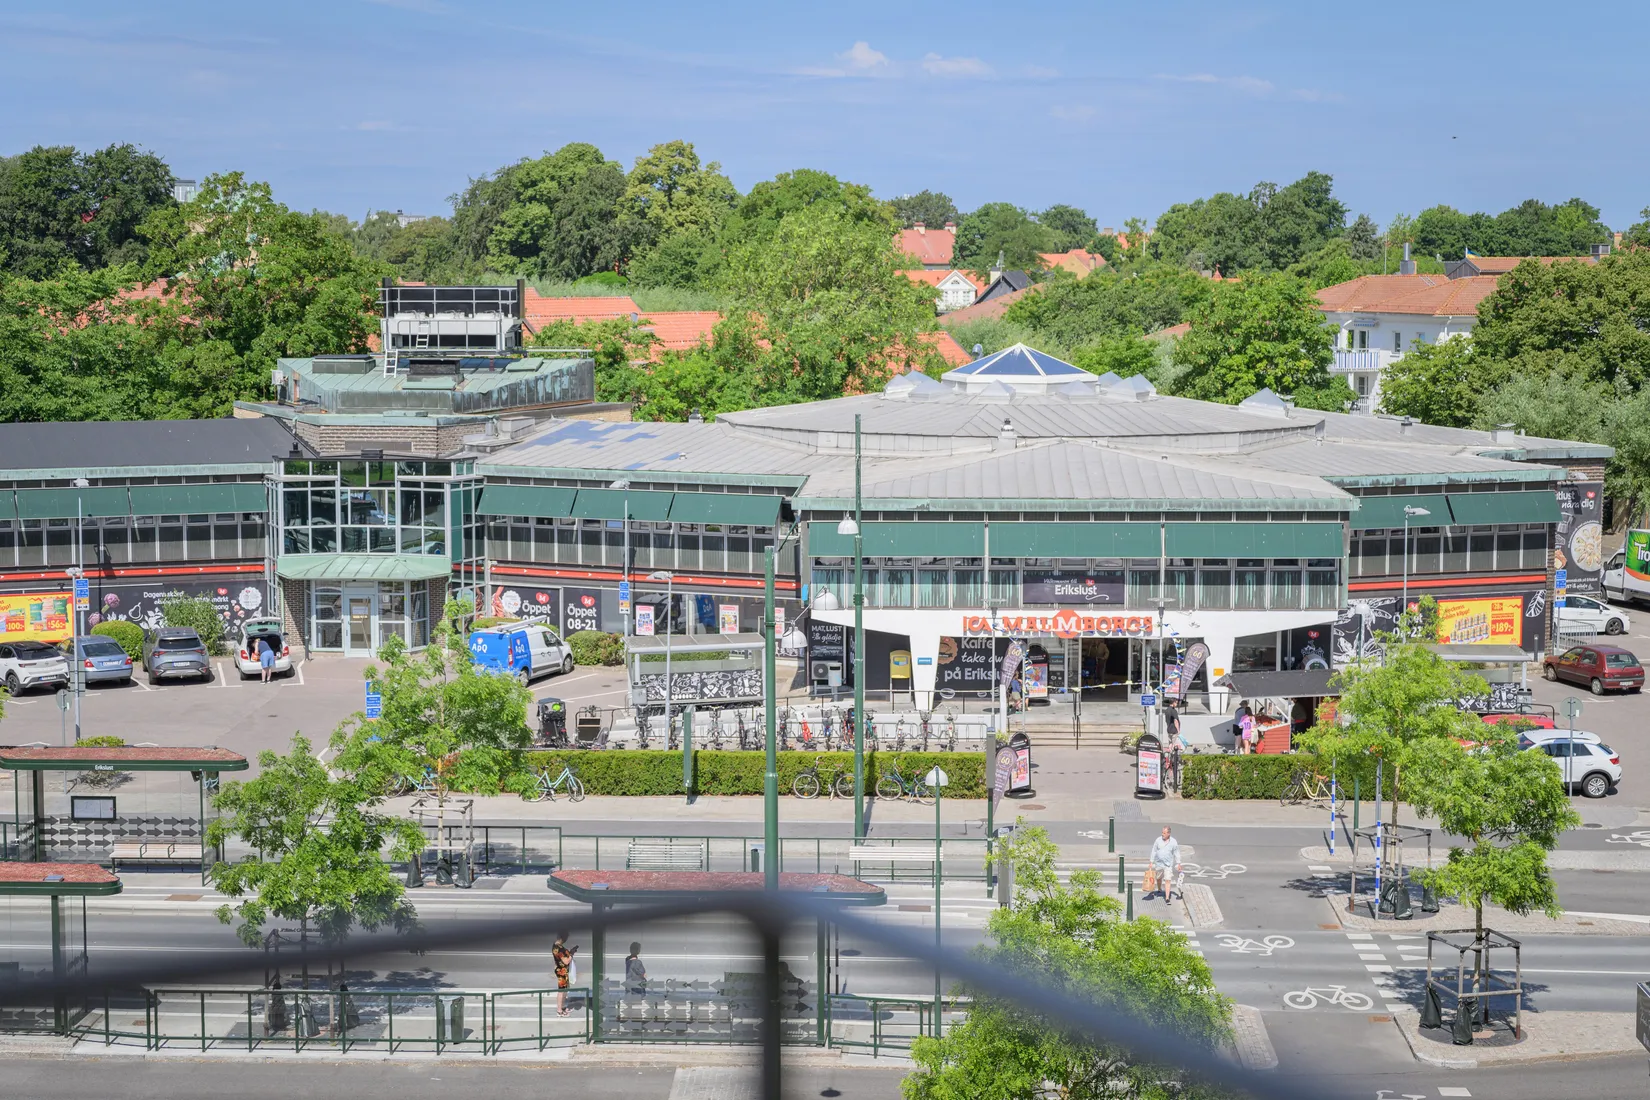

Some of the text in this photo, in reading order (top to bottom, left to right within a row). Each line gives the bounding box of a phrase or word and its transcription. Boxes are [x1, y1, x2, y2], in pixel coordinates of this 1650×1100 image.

[1581, 498, 1595, 510] dig
[1054, 584, 1098, 595] Erikslust
[522, 600, 551, 614] Öppet
[567, 603, 597, 618] Öppet
[567, 618, 597, 630] 08-21
[963, 614, 1152, 633] ICA MALMBORGS
[1393, 612, 1423, 625] Öet
[1393, 626, 1422, 638] 0-21
[471, 643, 488, 653] ApQ
[961, 637, 993, 649] Kaffe
[961, 651, 1003, 663] take aw
[1192, 650, 1203, 658] 60
[944, 666, 962, 682] på
[1000, 756, 1011, 765] 60
